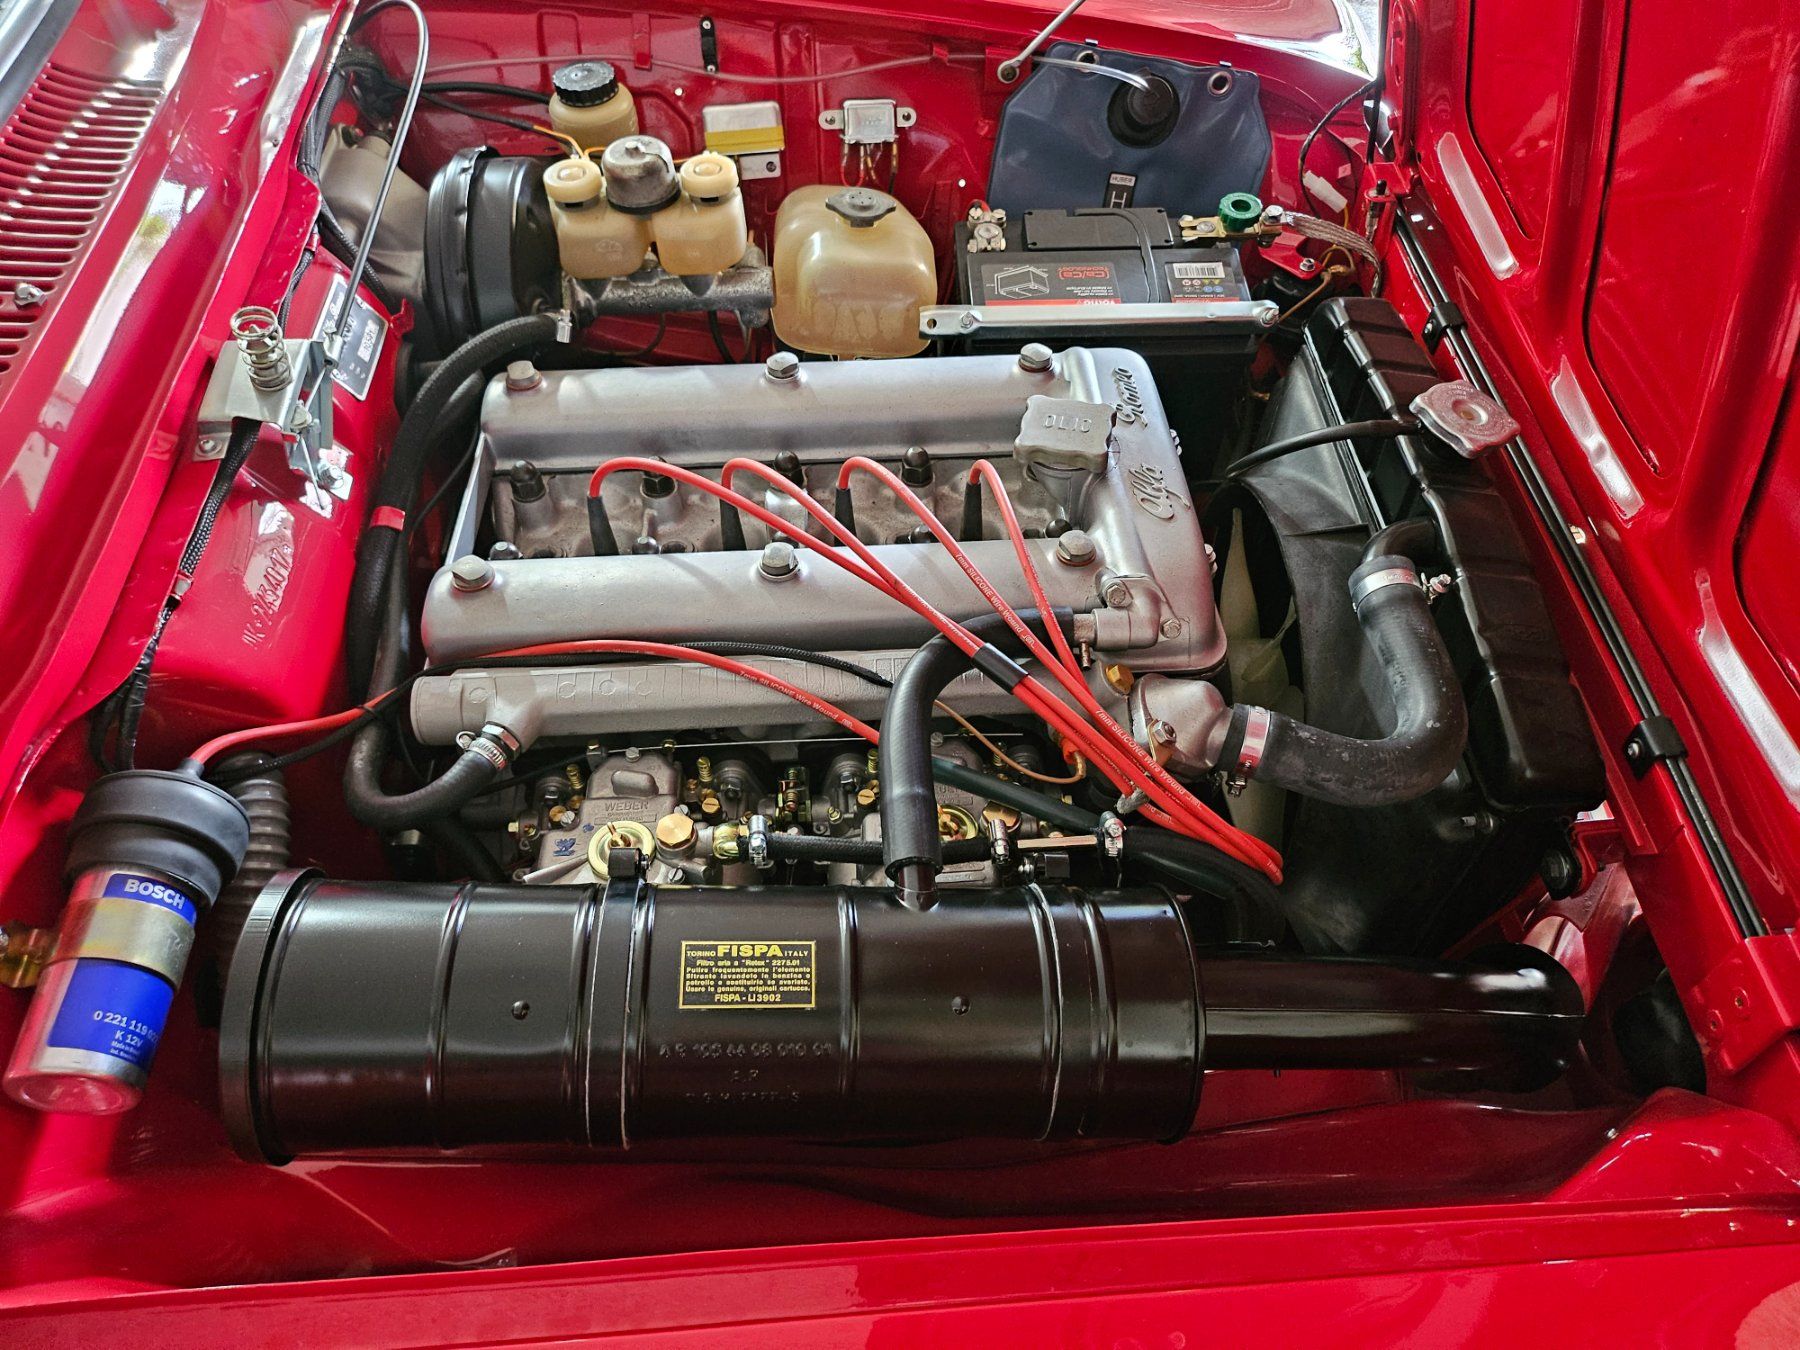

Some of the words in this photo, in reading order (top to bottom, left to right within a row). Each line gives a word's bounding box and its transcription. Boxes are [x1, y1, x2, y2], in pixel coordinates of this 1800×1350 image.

[967, 567, 993, 597] SILICONE
[990, 595, 1003, 612] Wire
[1002, 609, 1025, 633] Wound
[760, 678, 796, 697] SILICONE
[796, 692, 812, 706] Wire
[812, 702, 838, 720] Wound
[1112, 725, 1145, 756] SILICONE
[1144, 755, 1161, 773] Wire
[1160, 769, 1186, 795] Wound
[605, 801, 649, 812] WEBER
[124, 878, 185, 910] BOSCH
[717, 945, 783, 957] FISPA
[714, 994, 741, 1002] FISPA
[93, 1010, 103, 1022] 0
[104, 1012, 128, 1028] 221
[128, 1019, 148, 1036] 119
[115, 1030, 123, 1041] K
[126, 1032, 143, 1048] 12V
